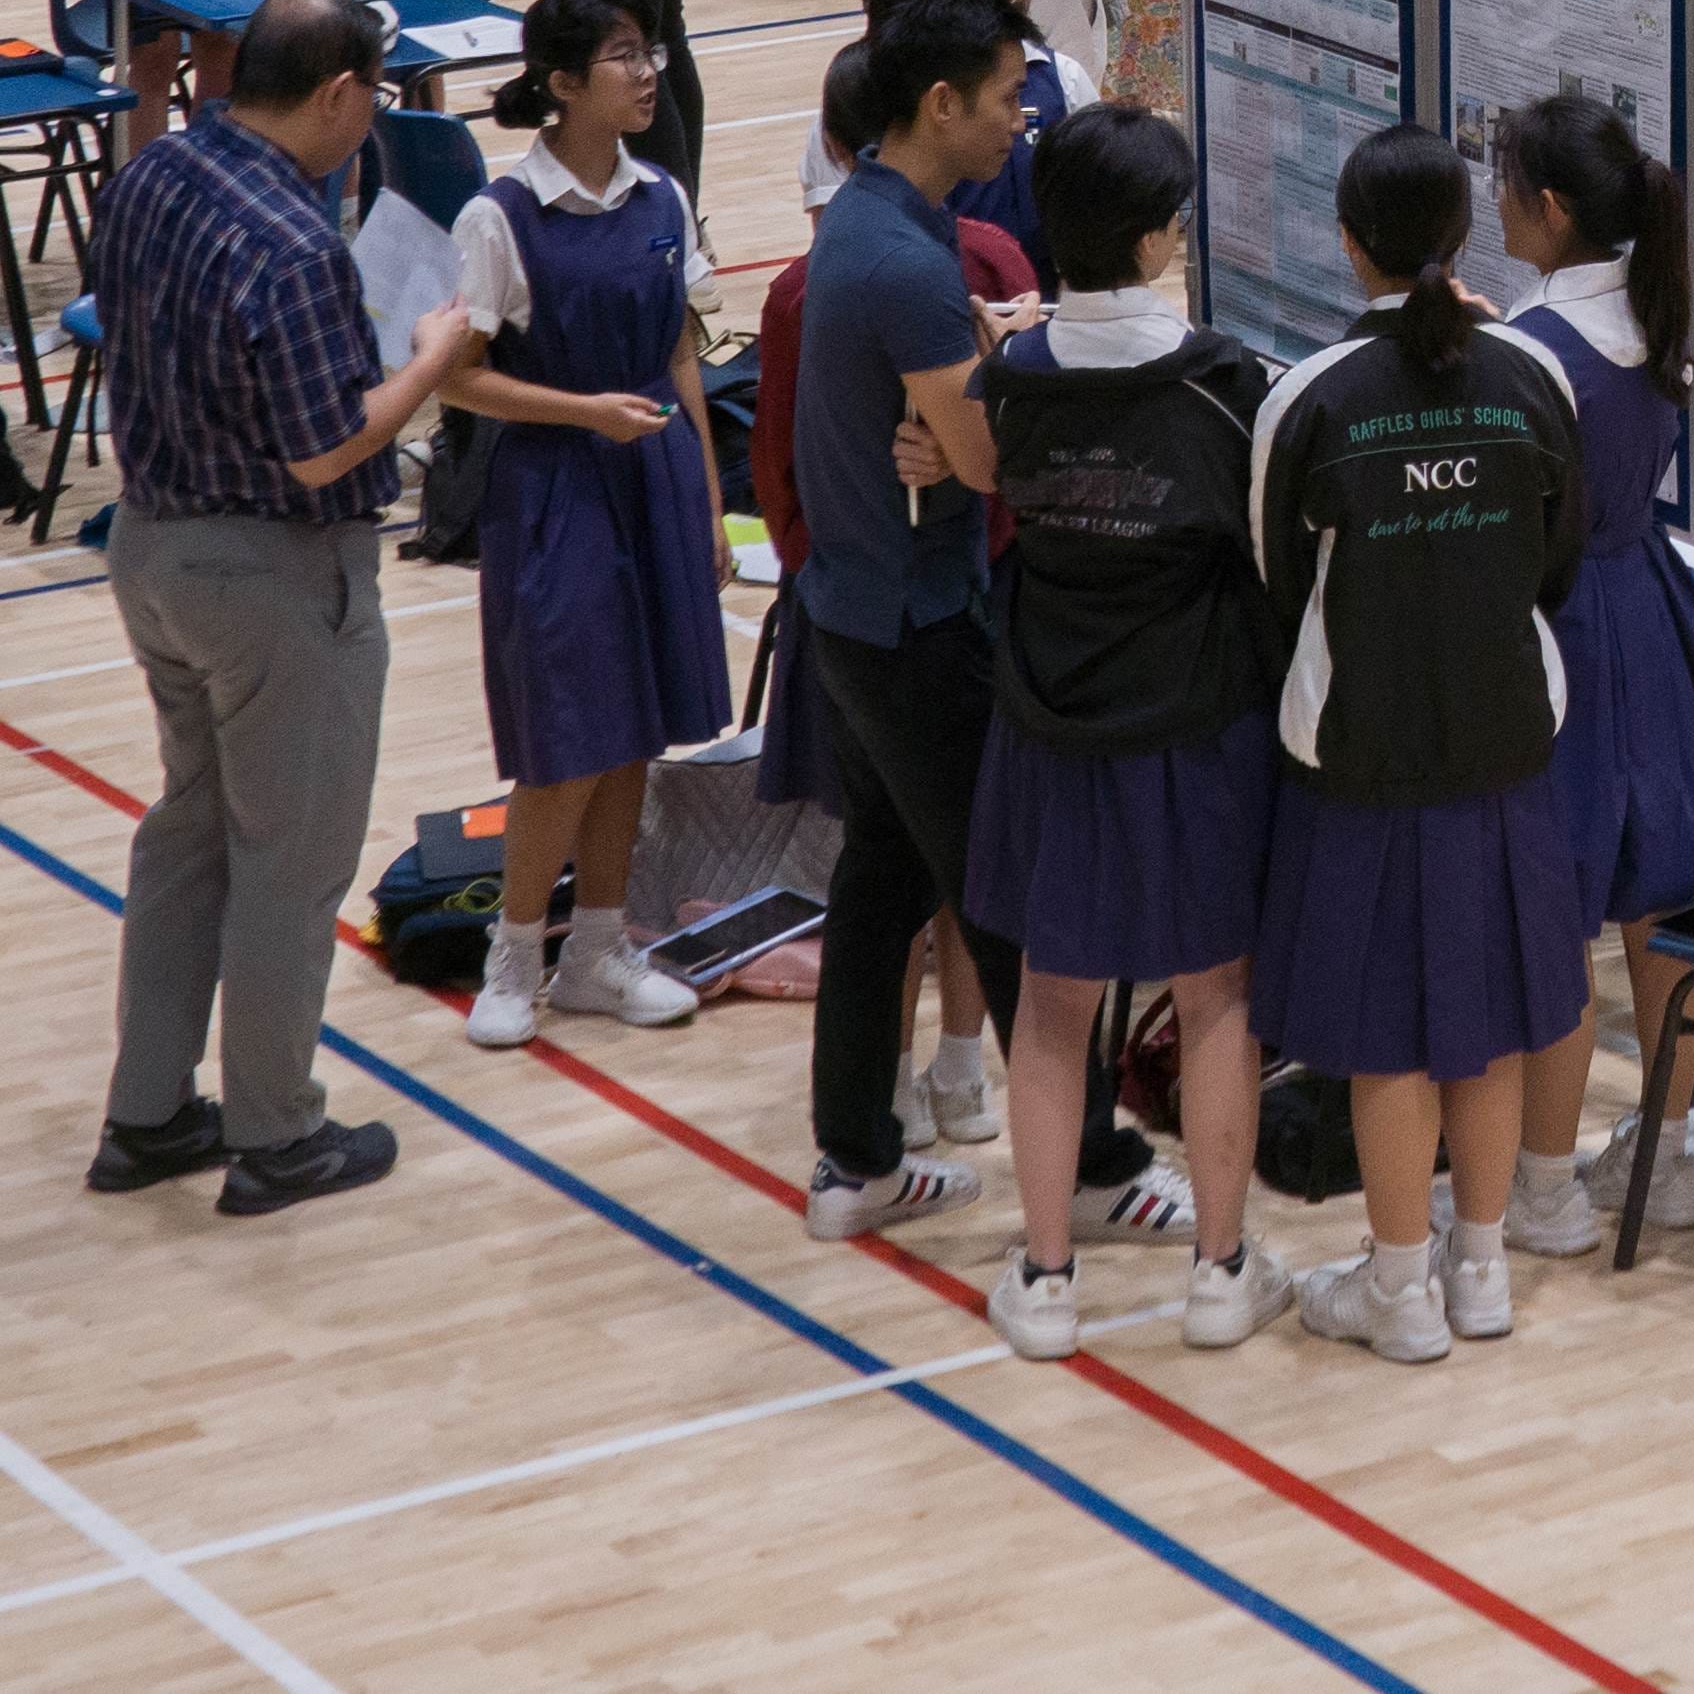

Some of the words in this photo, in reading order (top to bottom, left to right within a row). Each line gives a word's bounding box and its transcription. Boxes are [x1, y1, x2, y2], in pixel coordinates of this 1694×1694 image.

[1349, 413, 1414, 442] RAFFLES
[1420, 407, 1465, 429] GIRLS'
[1474, 406, 1528, 430] SCHOOL
[1403, 457, 1478, 493] NCC
[1368, 519, 1399, 539] dare
[1403, 512, 1422, 534] to
[1426, 508, 1449, 532] set
[1449, 502, 1475, 530] the
[1477, 508, 1512, 531] pace
